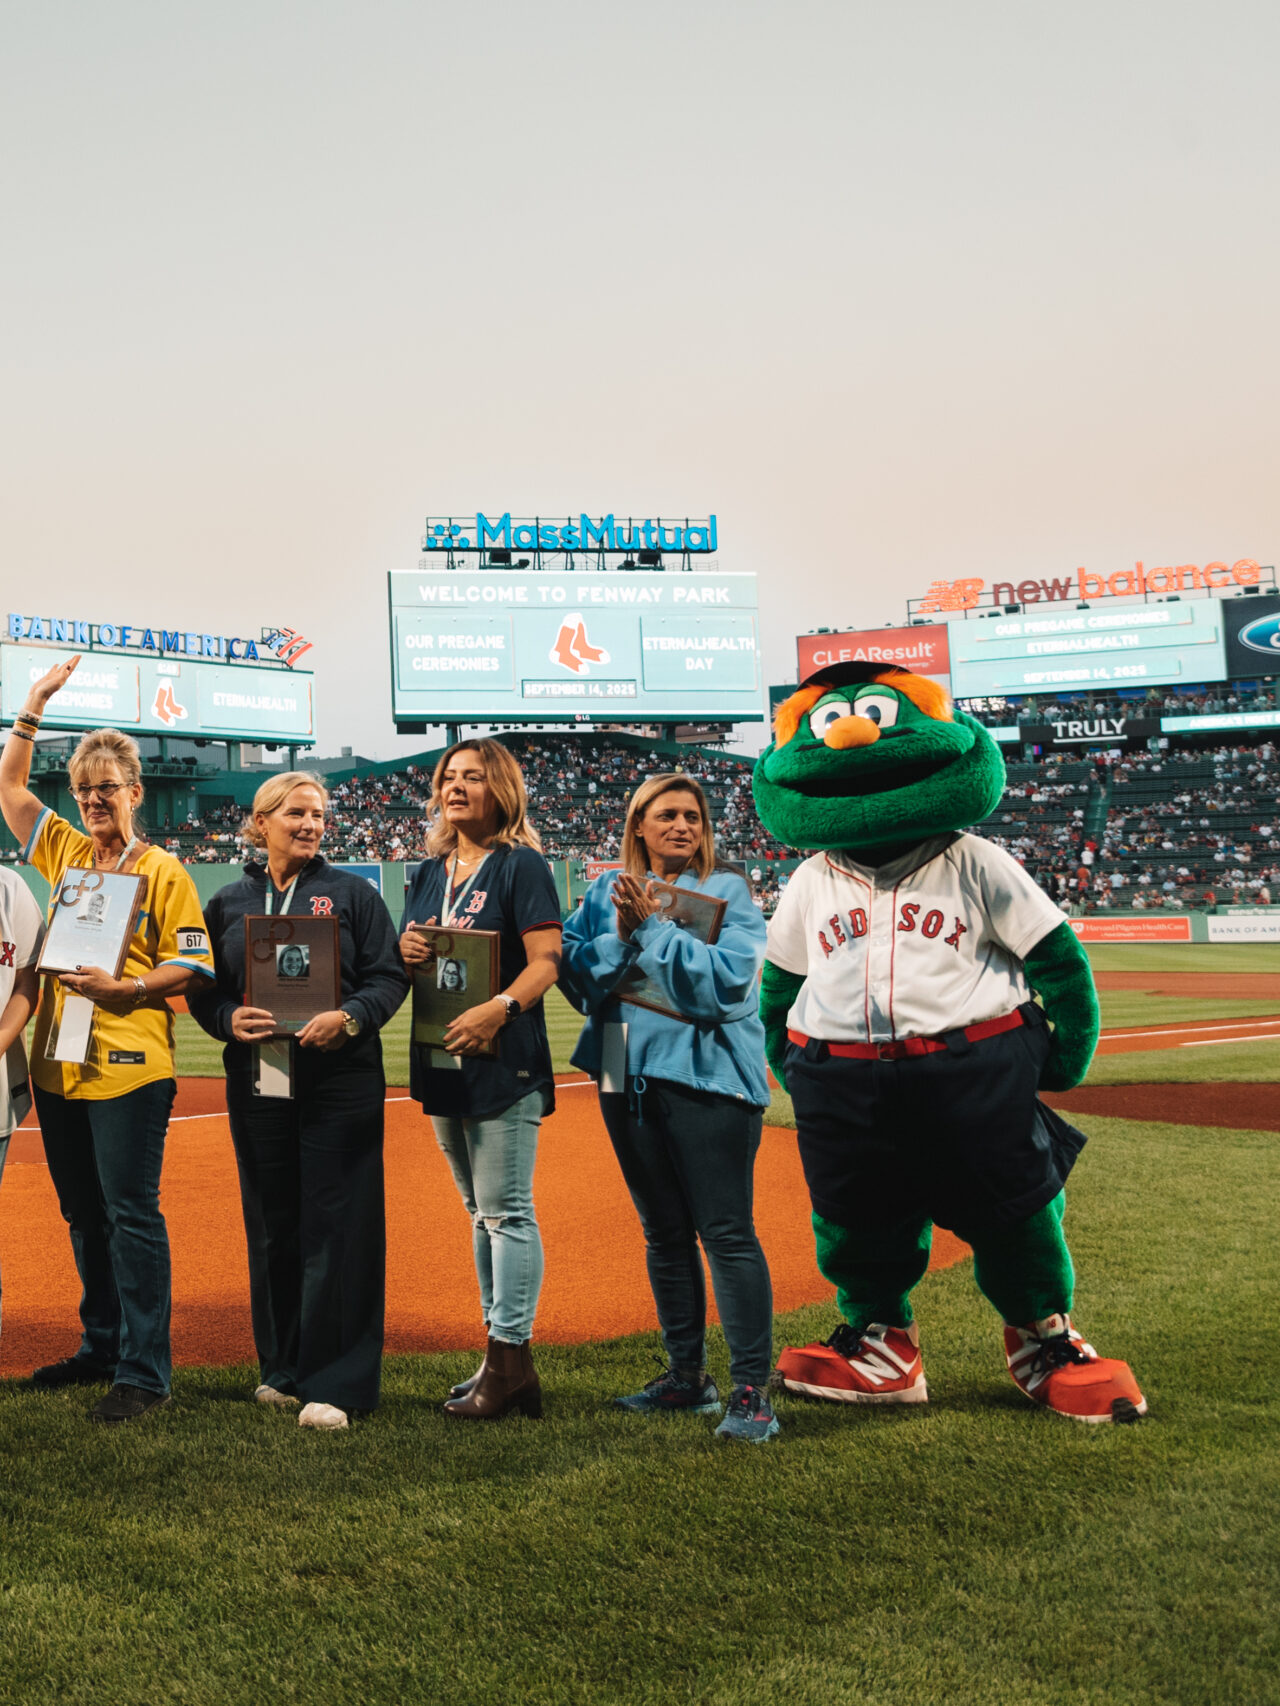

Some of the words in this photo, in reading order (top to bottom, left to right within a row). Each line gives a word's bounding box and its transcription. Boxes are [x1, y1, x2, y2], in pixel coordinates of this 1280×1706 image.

[476, 512, 717, 552] MassMutual
[992, 576, 1072, 606] new
[1077, 558, 1261, 599] balance
[419, 585, 528, 602] WELCOME
[538, 586, 566, 602] TO
[577, 586, 663, 602] FENWAY
[673, 586, 731, 603] PARK
[995, 623, 1021, 635] OUR
[1024, 617, 1086, 633] PREGAME
[1088, 610, 1170, 628] CEREMONIES
[8, 613, 90, 645] BANK
[98, 623, 133, 648] OF
[141, 628, 261, 660] AMERICA
[405, 635, 433, 649] OUR
[438, 635, 505, 649] PREGAME
[643, 637, 755, 651] ETERNALHEALTH
[1026, 634, 1139, 654] ETERNALHEALTH
[412, 657, 500, 671] CEREMONIES
[685, 657, 714, 671] DAY
[813, 642, 933, 666] CLEAResult
[1023, 668, 1090, 684] SEPTEMBER
[524, 684, 585, 695] SEPTEMBER
[589, 684, 603, 697] 14,
[607, 684, 636, 695] 2025
[213, 692, 297, 712] ETERNALHEALTH
[1051, 718, 1126, 738] TRULY
[310, 896, 334, 916] B
[464, 890, 487, 913] B
[818, 907, 868, 960] RED
[897, 902, 968, 952] SOX
[1142, 923, 1166, 931] Health
[186, 934, 202, 947] 617
